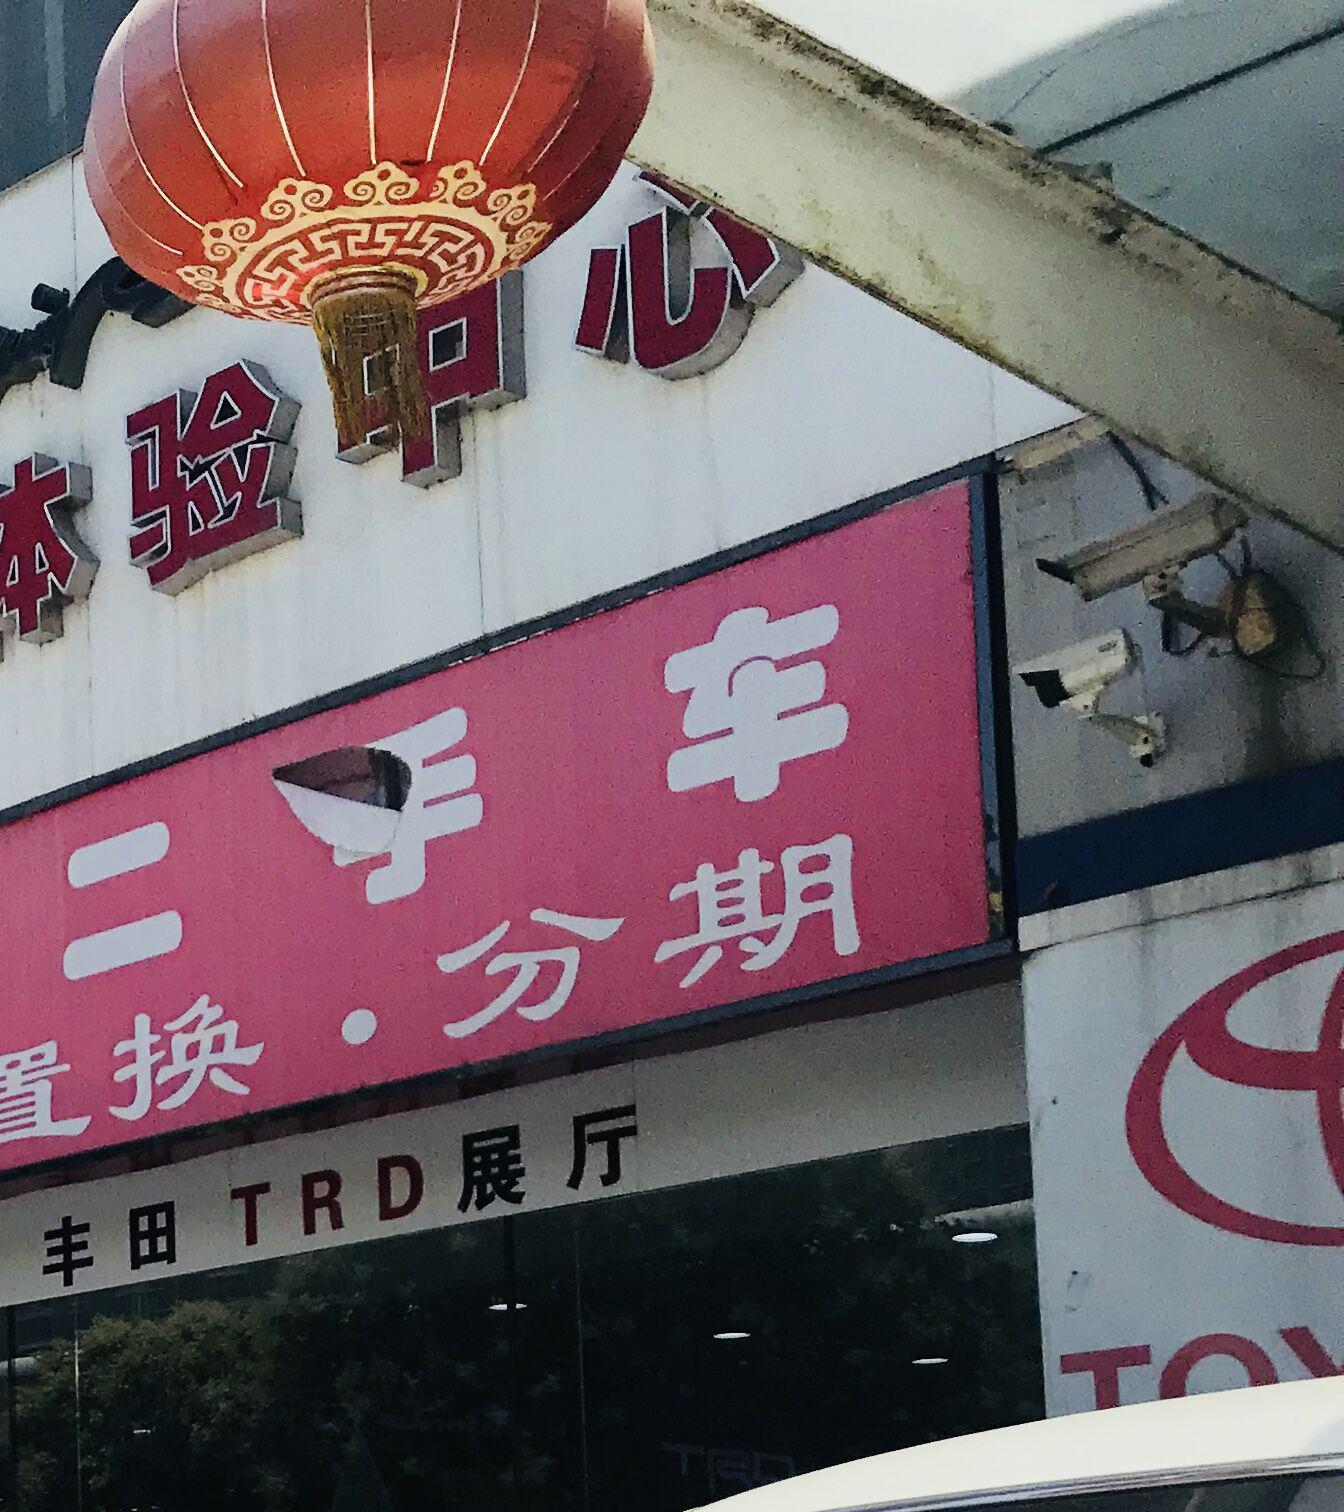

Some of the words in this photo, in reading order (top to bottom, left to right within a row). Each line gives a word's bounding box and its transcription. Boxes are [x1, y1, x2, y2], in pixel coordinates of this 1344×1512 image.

[42, 1200, 177, 1287] 丰田
[231, 1154, 424, 1246] TRD
[458, 1104, 638, 1213] 展厅
